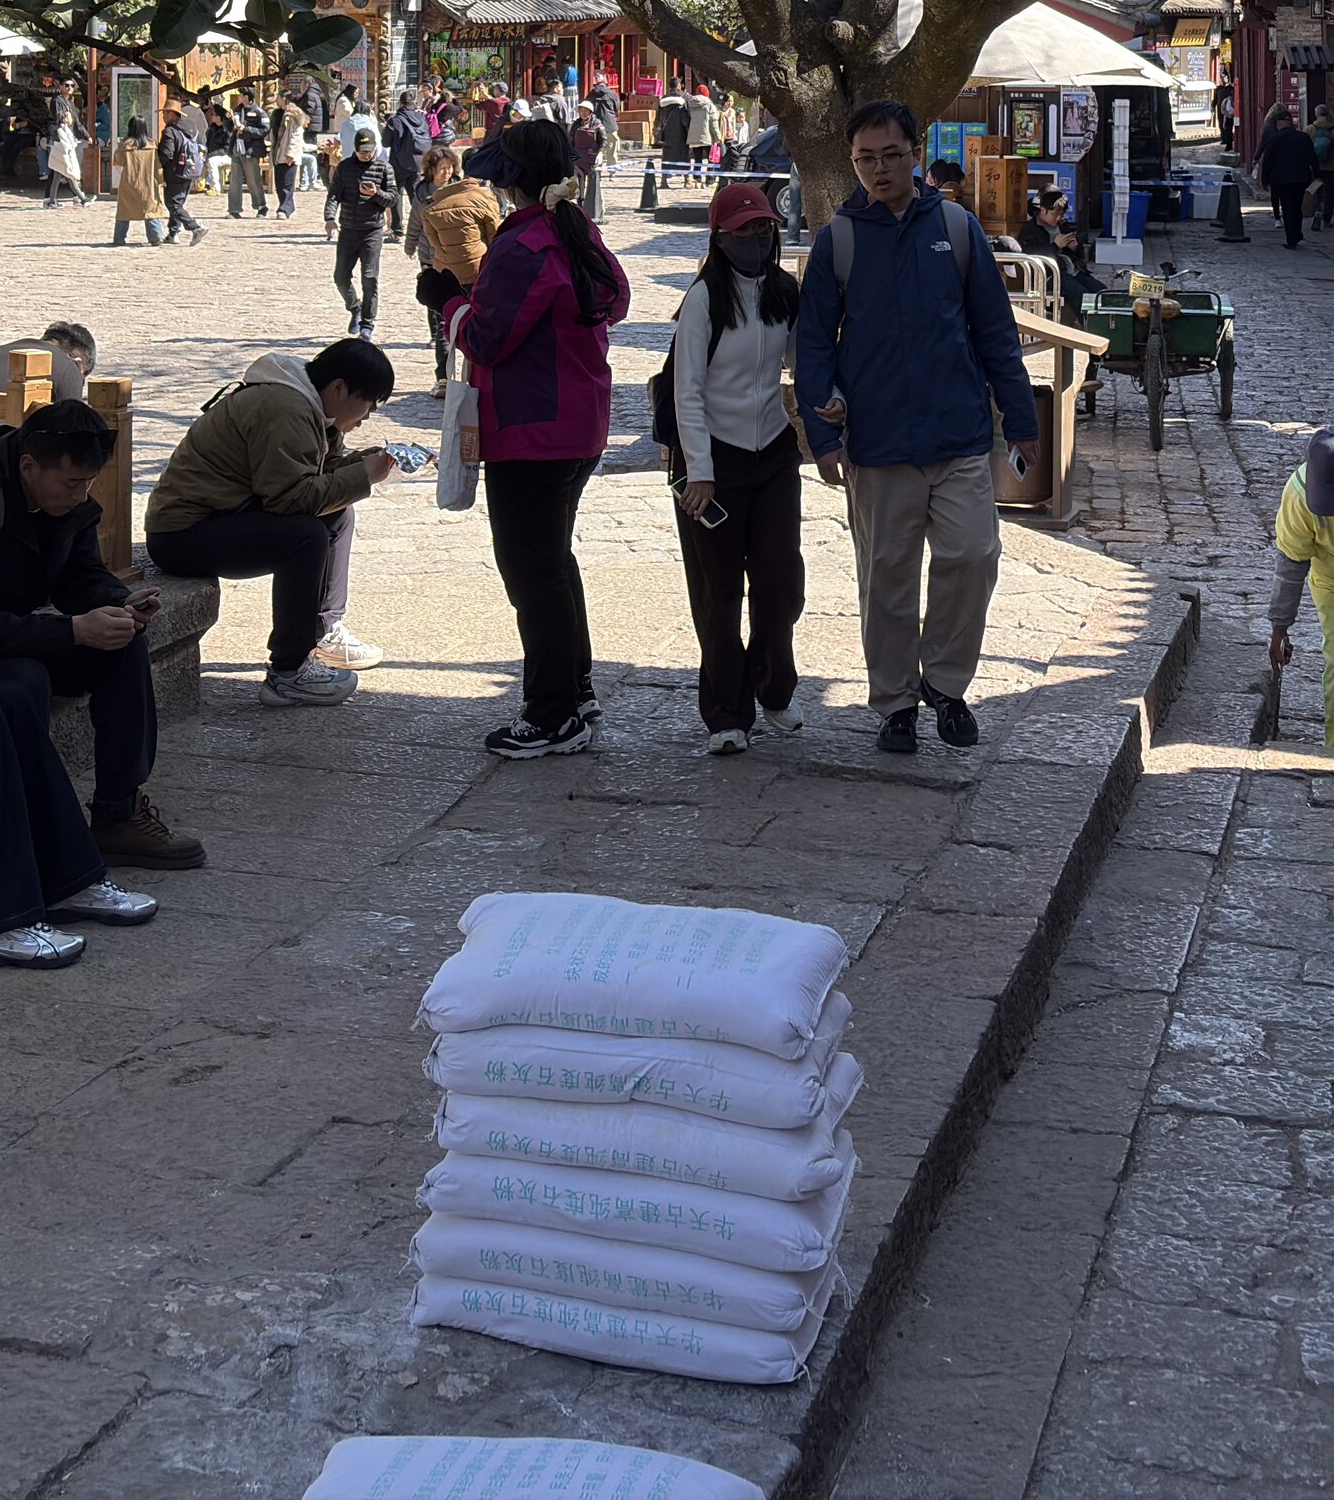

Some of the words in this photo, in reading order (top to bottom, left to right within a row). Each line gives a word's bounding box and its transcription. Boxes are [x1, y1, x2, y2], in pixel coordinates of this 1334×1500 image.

[485, 1058, 733, 1114] 华天古建高纯度石灰粉
[485, 1129, 730, 1190] 华天古建高纯度石灰粉
[492, 1175, 736, 1241] 华天古建高纯度石灰粉
[478, 1248, 725, 1313] 华天古建高纯度石灰粉
[460, 1287, 705, 1357] 华天古建高纯度石灰粉
